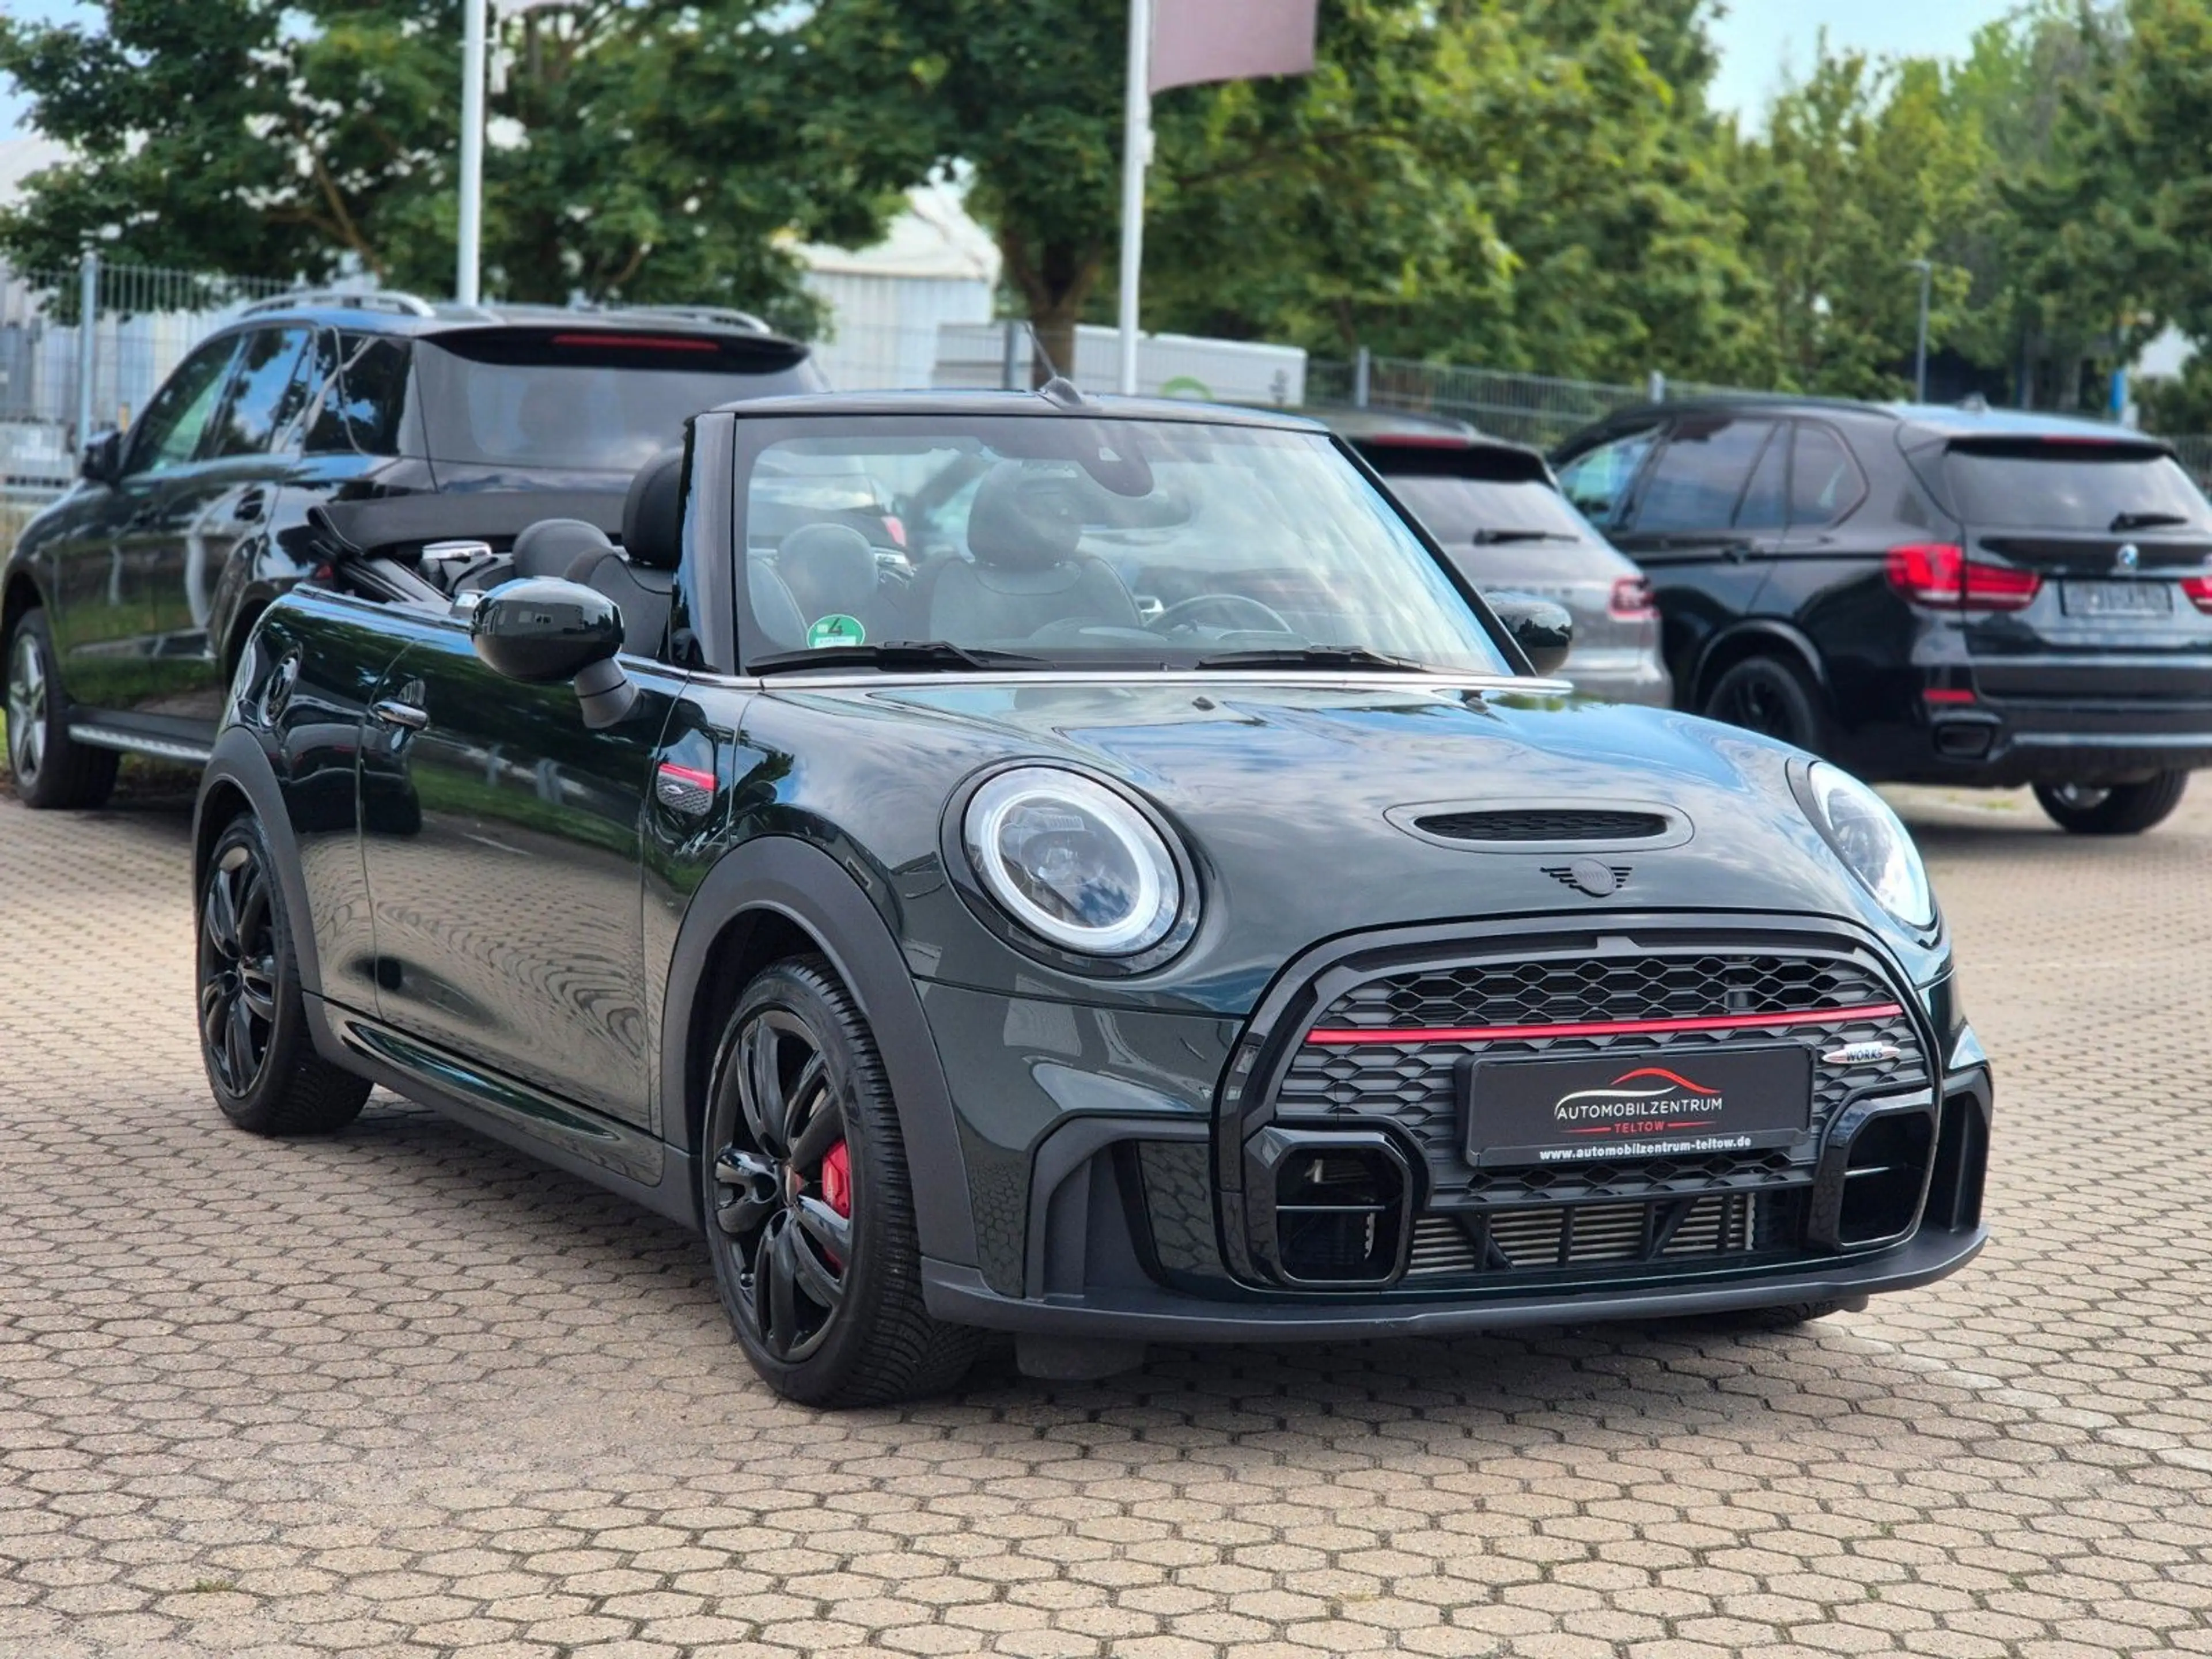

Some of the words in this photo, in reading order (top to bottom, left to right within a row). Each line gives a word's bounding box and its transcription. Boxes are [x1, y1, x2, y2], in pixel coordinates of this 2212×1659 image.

[828, 617, 843, 637] 4
[1846, 1048, 1883, 1062] WORKS
[1556, 1097, 1723, 1120] AUTOMOBILZENTRUM
[1614, 1120, 1665, 1134] TELTOW
[1540, 1135, 1752, 1160] www.automobilzentrum-teltow.de
